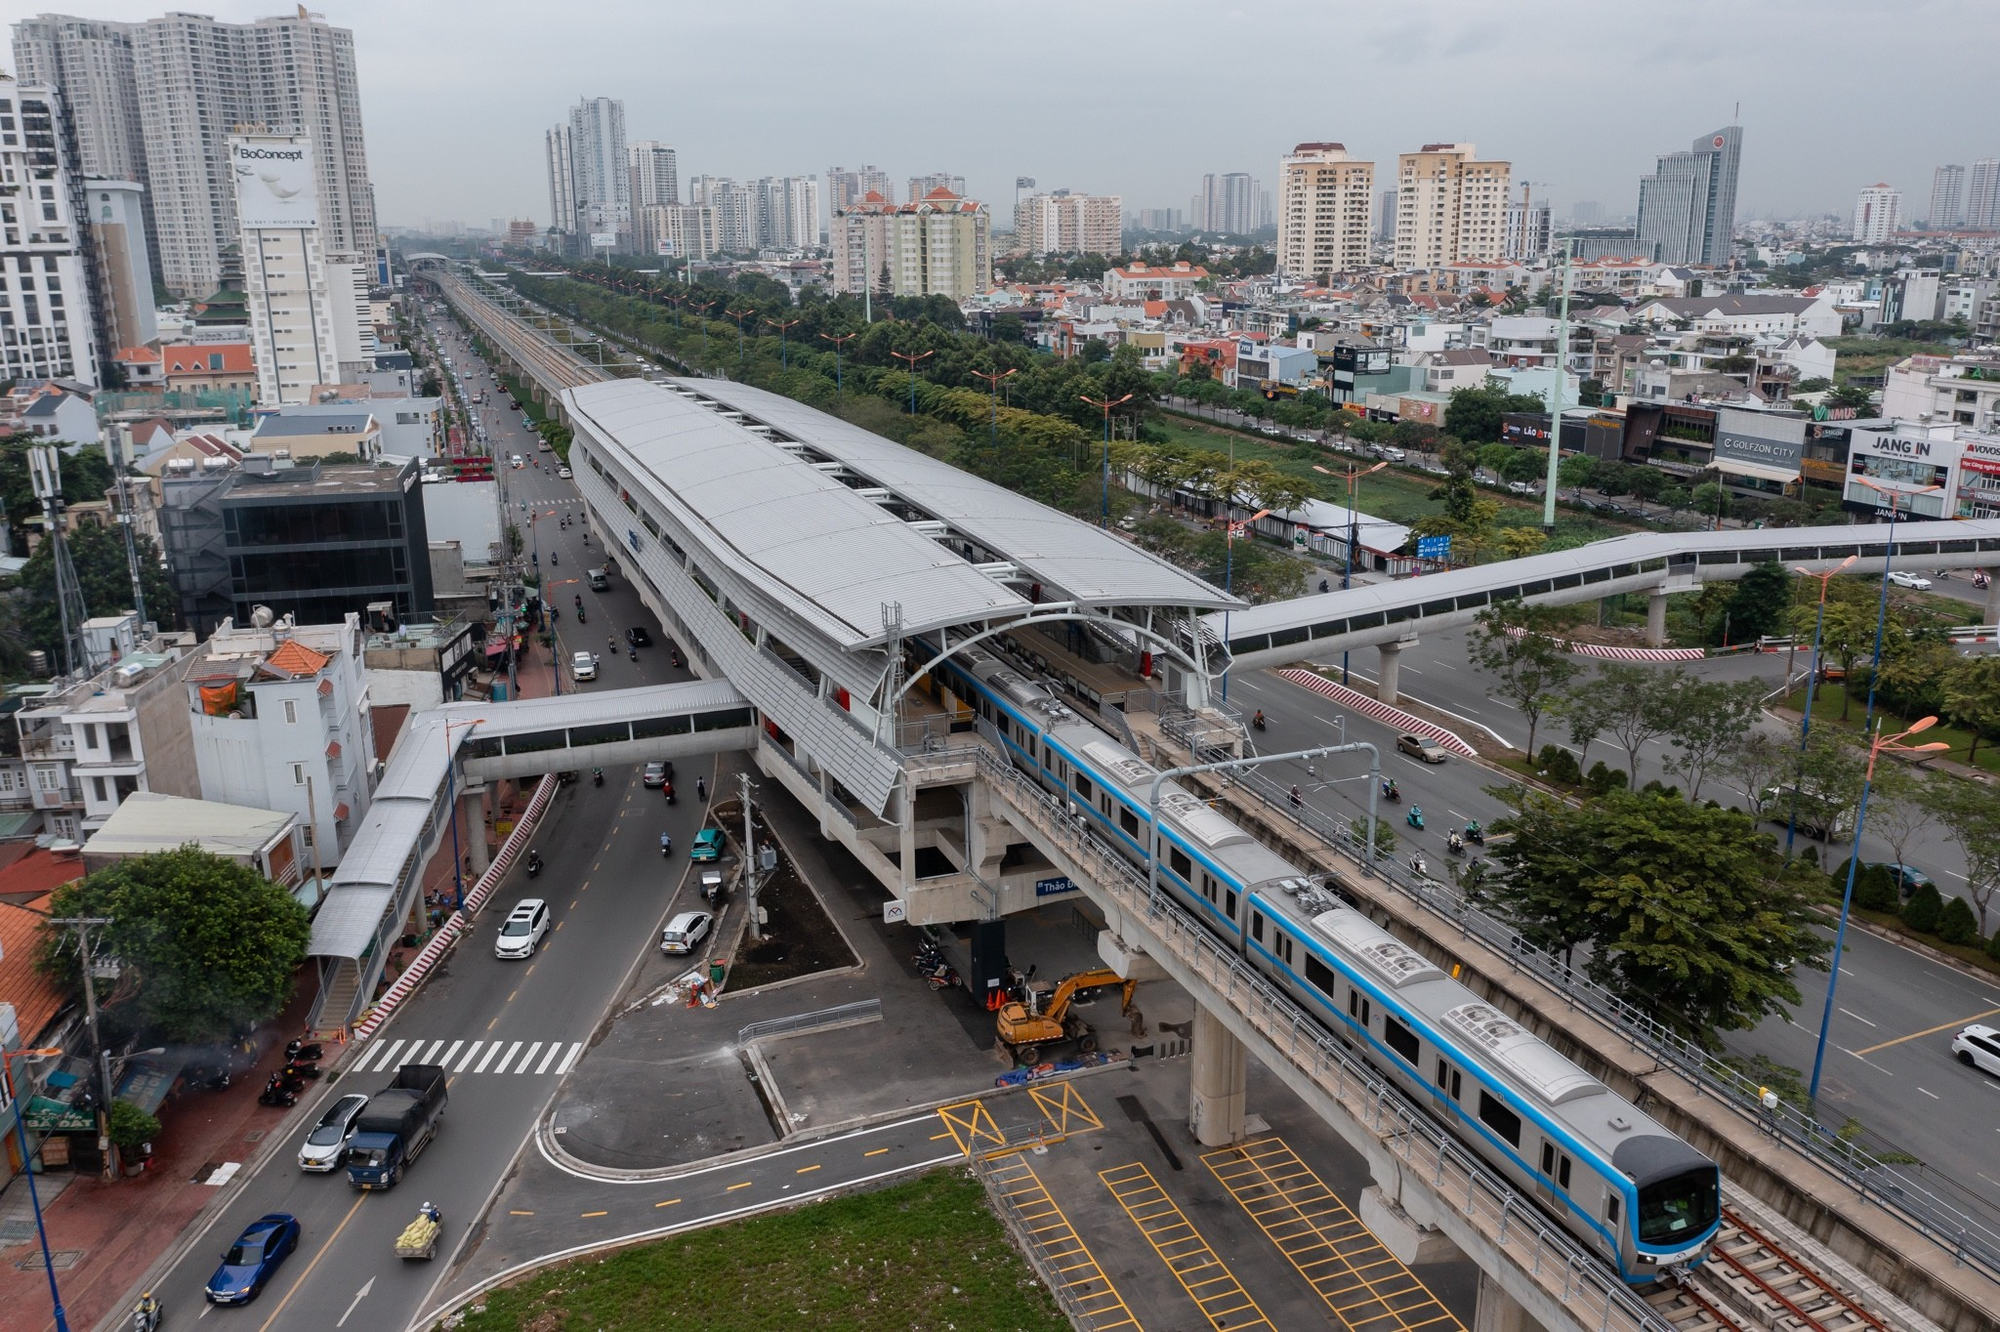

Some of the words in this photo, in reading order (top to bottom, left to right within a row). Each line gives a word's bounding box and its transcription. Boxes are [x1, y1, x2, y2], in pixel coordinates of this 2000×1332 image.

[241, 149, 303, 161] BoConcept
[1733, 440, 1771, 454] GOLFZON
[1773, 447, 1795, 458] CITY
[1872, 437, 1912, 452] JANG
[1914, 442, 1931, 456] IN
[1044, 881, 1065, 892] Thảo
